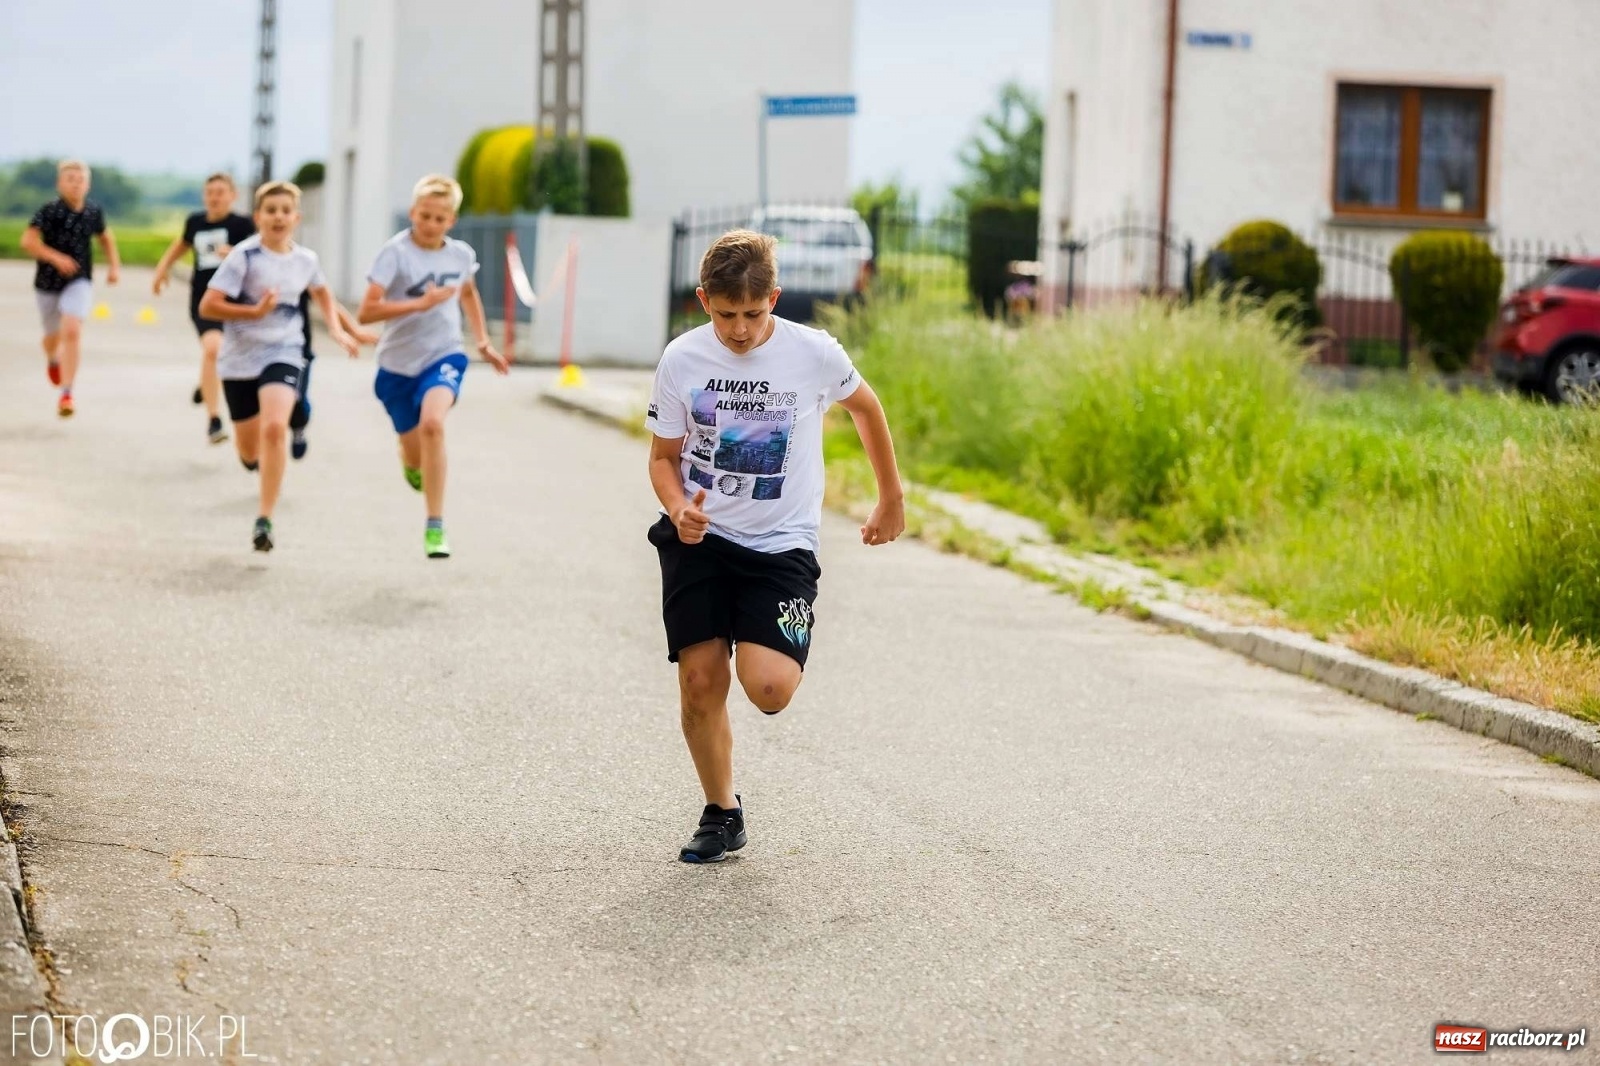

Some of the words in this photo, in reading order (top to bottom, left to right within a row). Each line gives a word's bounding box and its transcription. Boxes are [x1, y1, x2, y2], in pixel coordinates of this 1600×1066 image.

[704, 379, 770, 394] ALWAYS
[729, 391, 798, 407] FOREVS
[715, 400, 766, 412] ALWAYS
[734, 410, 787, 421] FOREVS
